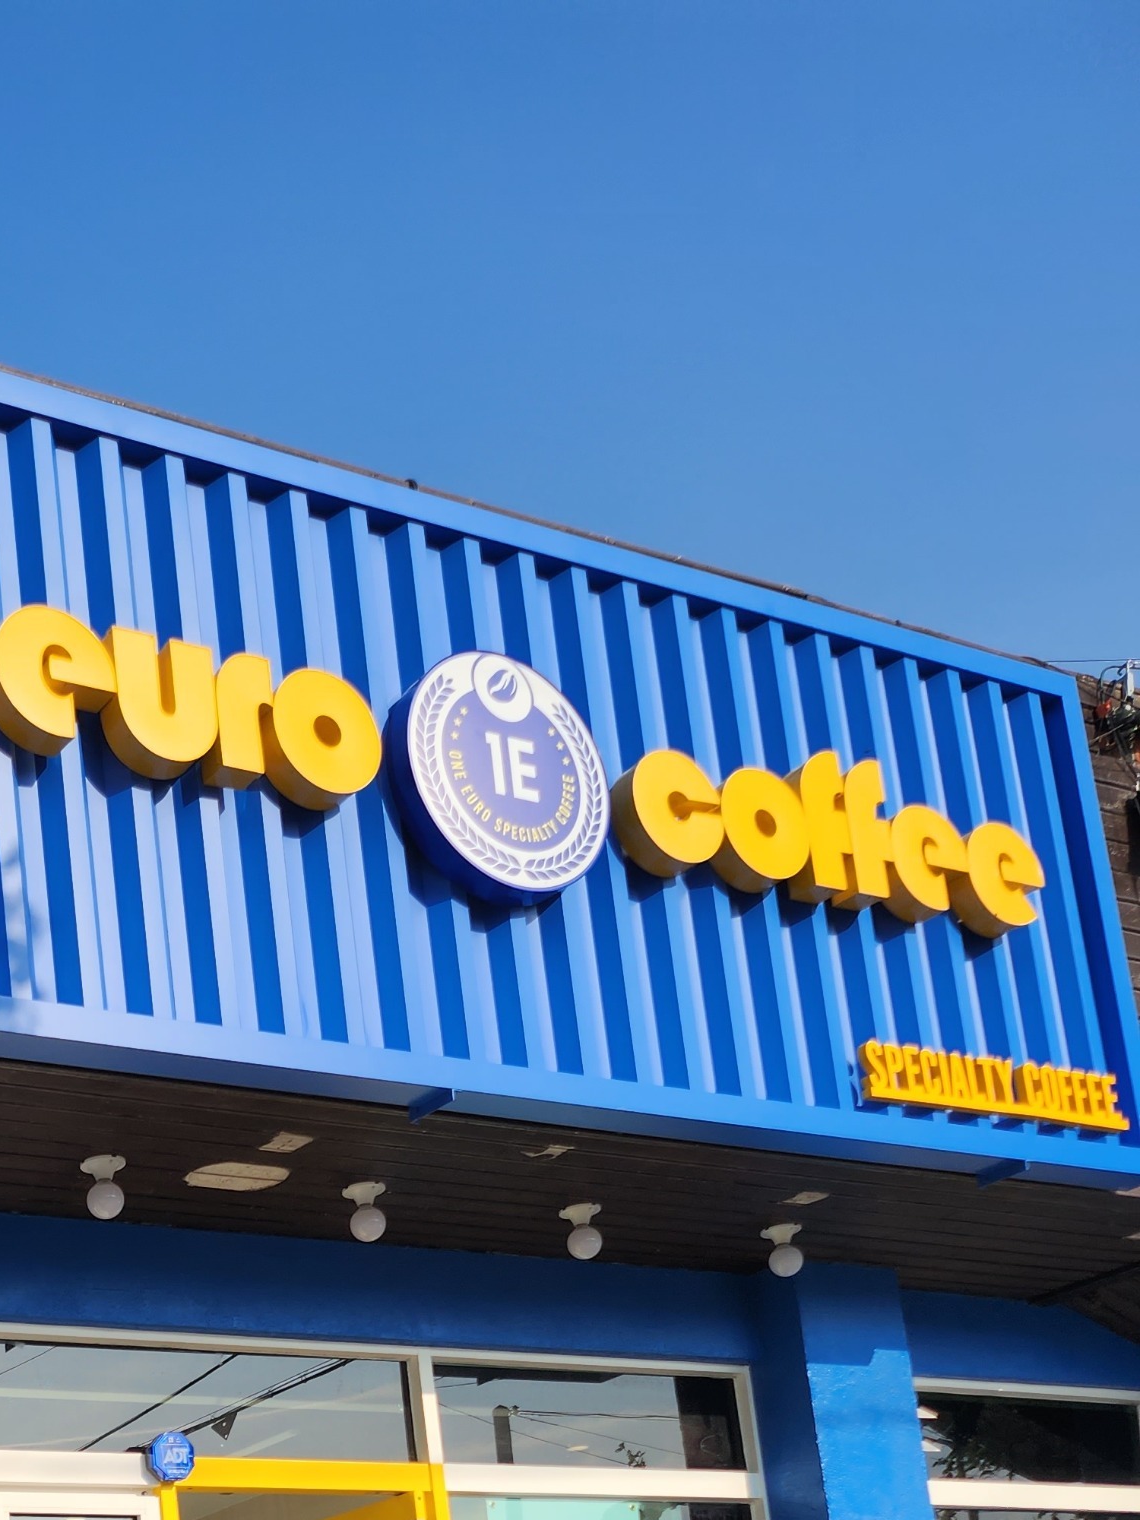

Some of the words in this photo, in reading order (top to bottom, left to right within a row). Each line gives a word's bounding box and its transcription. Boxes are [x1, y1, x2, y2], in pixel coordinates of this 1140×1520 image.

[448, 750, 467, 781] ONE
[461, 784, 492, 823] EURO
[493, 816, 559, 844] SPECIALTY
[554, 773, 576, 826] COFFEE
[485, 731, 540, 803] 1E
[610, 749, 1046, 938] coffee
[861, 1040, 1014, 1105] SPECIALTY
[1017, 1062, 1120, 1122] COFFEE
[163, 1447, 188, 1464] ADT
